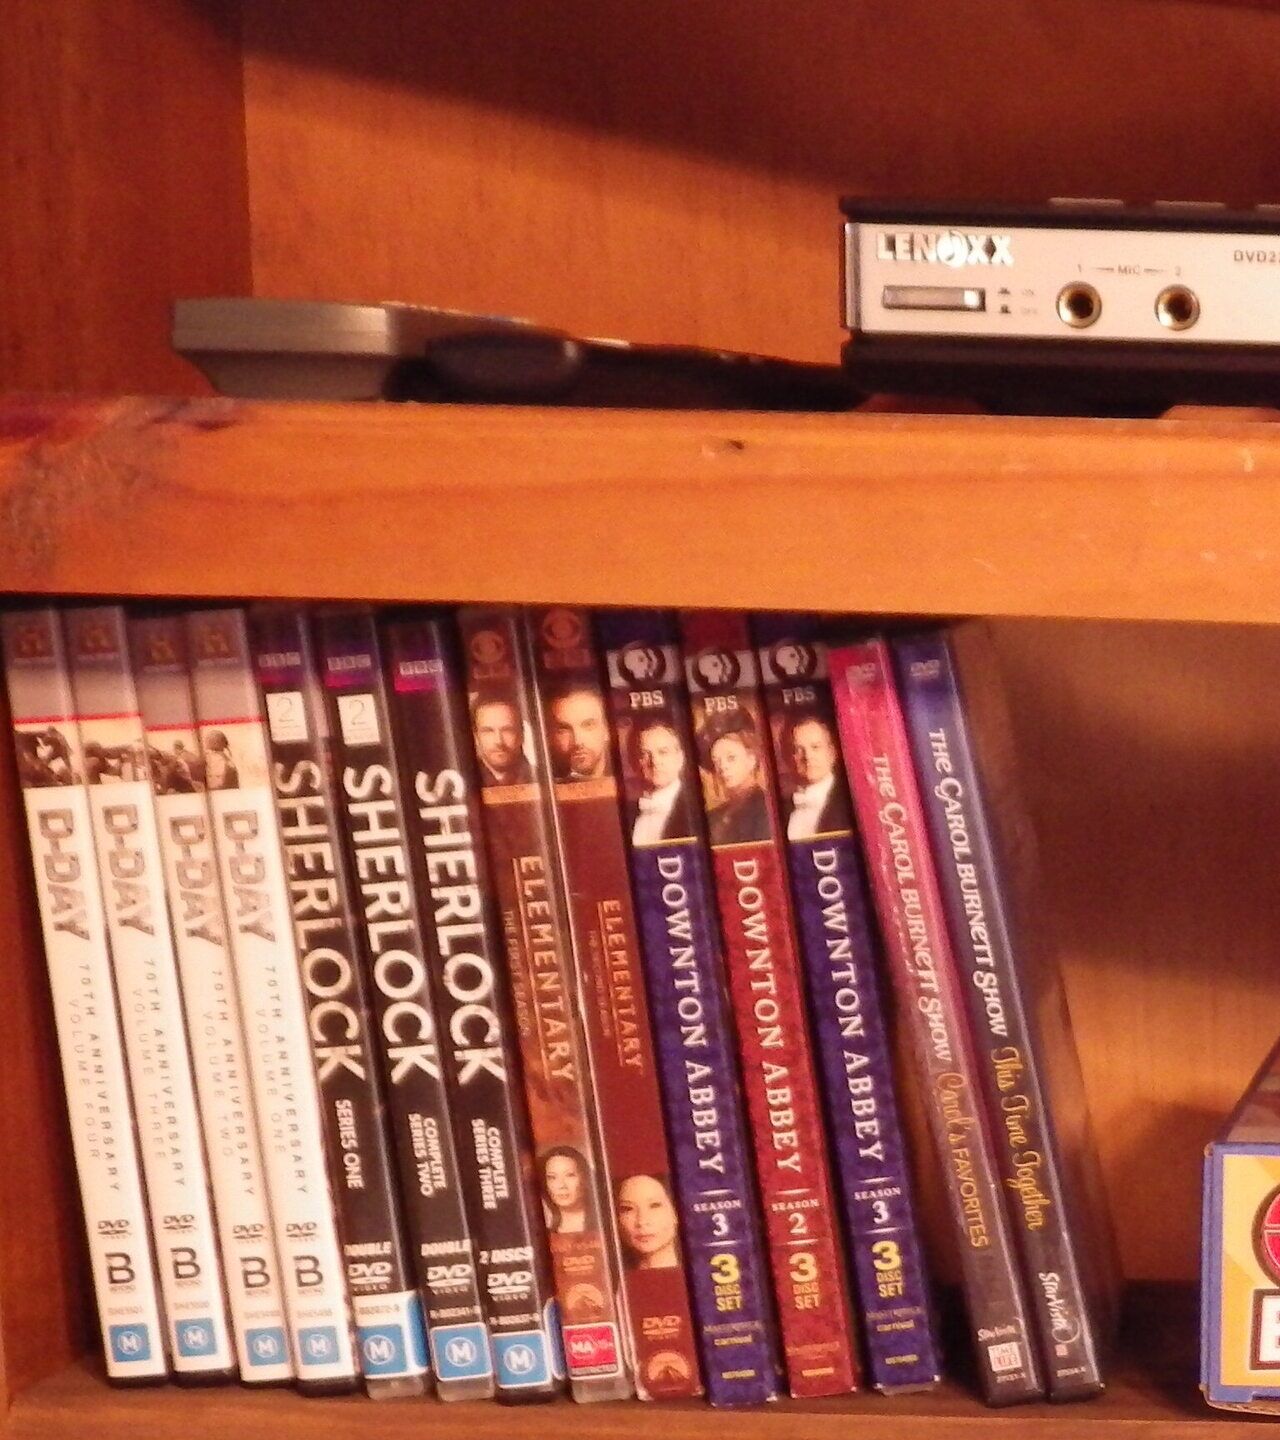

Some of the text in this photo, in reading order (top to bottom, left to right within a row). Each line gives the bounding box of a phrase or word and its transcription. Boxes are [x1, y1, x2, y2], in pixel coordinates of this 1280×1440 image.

[876, 231, 1015, 268] LENOXX
[629, 690, 664, 707] PBS
[704, 697, 738, 713] PBS
[781, 687, 816, 704] PBS
[936, 775, 973, 863] CAROL
[37, 807, 91, 941] D-DAY
[102, 804, 155, 936] D-DAY
[169, 815, 225, 946] D-DAY
[222, 810, 276, 943] D-DAY
[274, 759, 366, 1083] SHERLOCK
[343, 763, 441, 1085] SHERLOCK
[415, 769, 507, 1087] SHERLOCK
[519, 855, 576, 1082] ELEMENTARY
[602, 900, 644, 1076] ELEMENTARY
[812, 848, 885, 1163] DOWNTON ABBEY
[972, 968, 1008, 1038] SHOW
[657, 855, 725, 1174] DOWNTON ABBEY
[733, 859, 801, 1173] DOWNTON ABBEY
[878, 801, 916, 886] CAROL
[917, 994, 953, 1062] SHOW
[952, 1148, 989, 1248] FAVORITES
[153, 1028, 186, 1187] ANNIVERSARY
[991, 1046, 1024, 1092] This
[89, 1033, 121, 1192] ANNIVERSARY
[222, 1038, 255, 1196] ANNIVERSARY
[275, 1035, 308, 1195] ANNIVERSARY
[335, 1099, 365, 1189] SERIES ONE
[422, 1117, 447, 1189] COMPLETE
[1001, 1094, 1030, 1148] Time
[408, 1113, 434, 1197] SERIES TWO
[471, 1118, 498, 1210] SERIES THREE
[486, 1127, 509, 1200] COMPLETE
[854, 1187, 901, 1201] SEASON
[1004, 1150, 1051, 1231] Together
[693, 1200, 742, 1213] SEASON
[711, 1213, 729, 1236] 3
[772, 1199, 820, 1212] SEASON
[789, 1212, 807, 1234] 2
[872, 1200, 890, 1224] 3
[710, 1253, 741, 1284] 3
[789, 1252, 818, 1283] 3
[871, 1240, 902, 1271] 3
[878, 1282, 904, 1298] SET
[716, 1296, 742, 1312] SET
[795, 1295, 820, 1310] SET
